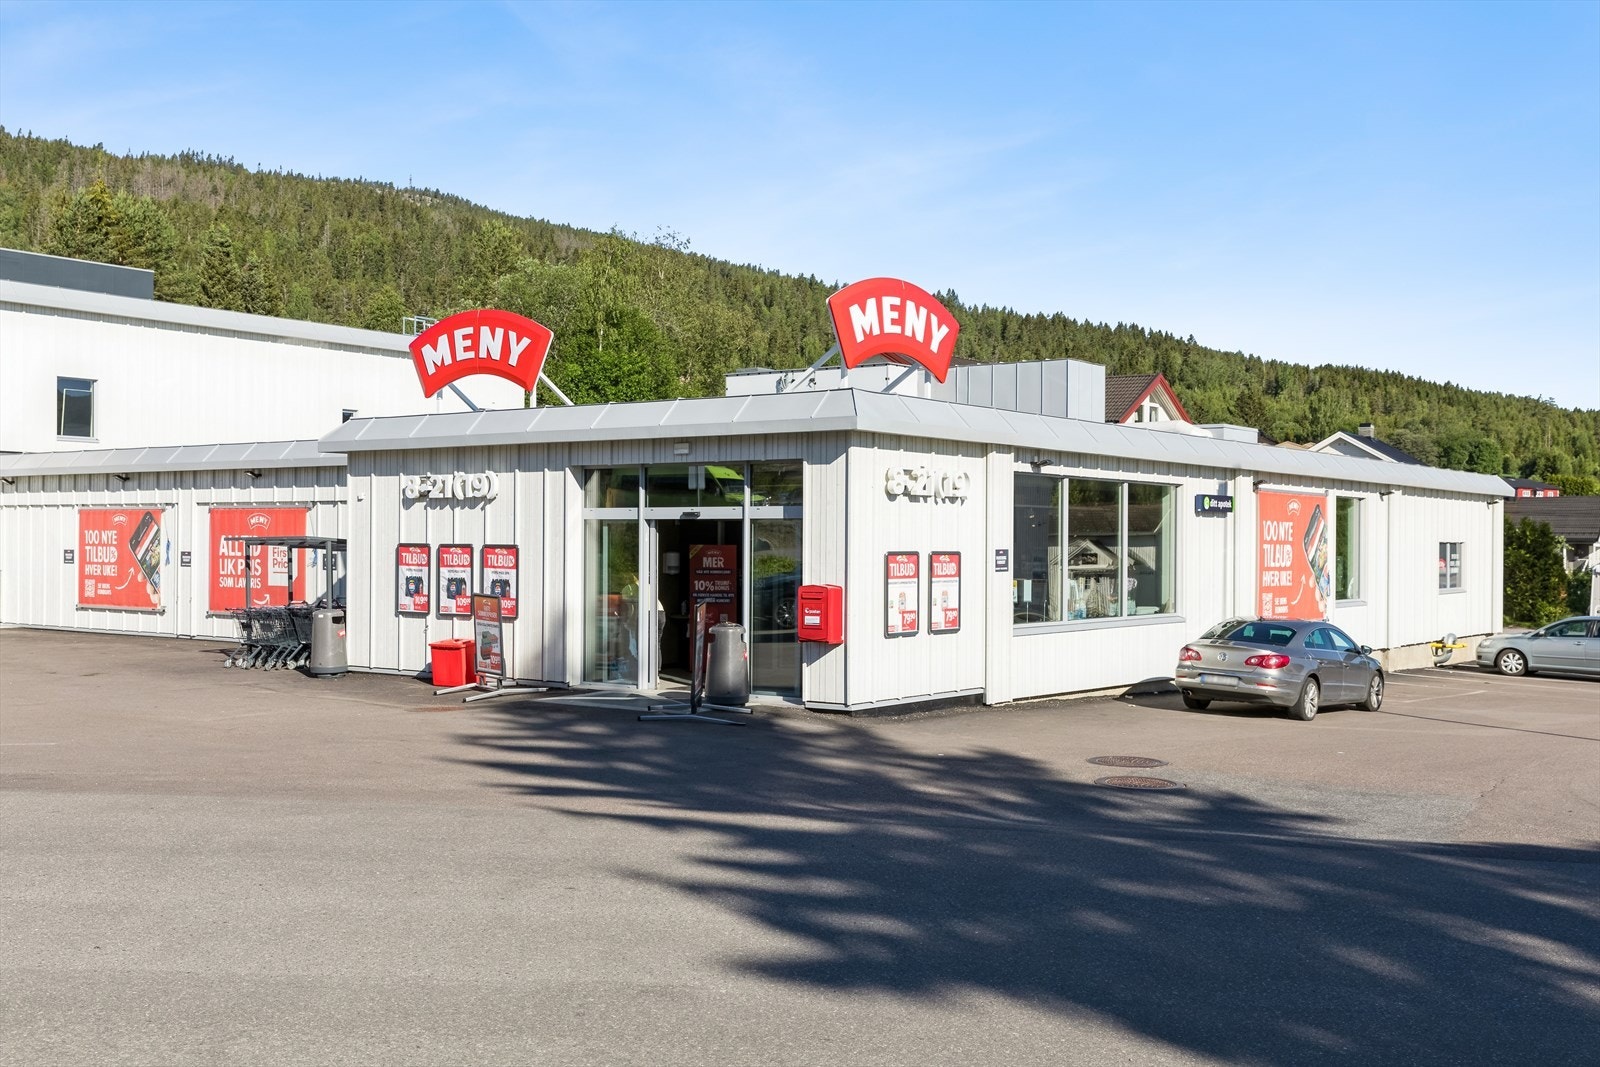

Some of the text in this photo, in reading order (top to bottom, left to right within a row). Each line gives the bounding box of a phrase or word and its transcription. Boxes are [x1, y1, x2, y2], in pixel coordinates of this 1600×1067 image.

[848, 296, 950, 354] MENY
[421, 326, 532, 376] MENY
[404, 470, 498, 500] 8-21(19)
[250, 515, 268, 525] MENY
[84, 530, 117, 544] 100 NYE
[1263, 521, 1293, 541] 100 NYE
[85, 546, 118, 563] TILBUD
[272, 547, 287, 557] Firs
[1263, 544, 1293, 568] TILBUD
[272, 558, 288, 569] Pric
[401, 553, 428, 565] TILBUD
[443, 554, 471, 566] TILBUD
[487, 554, 515, 567] TILBUD
[702, 556, 725, 568] MER
[85, 564, 118, 576] HVER UKE!
[219, 559, 261, 576] LIK PIS
[889, 563, 916, 576] TILBUD
[933, 563, 957, 576] TILBUD
[219, 577, 261, 589] SOM LAVRIS
[694, 580, 715, 591] 10%
[1262, 571, 1279, 587] HVER
